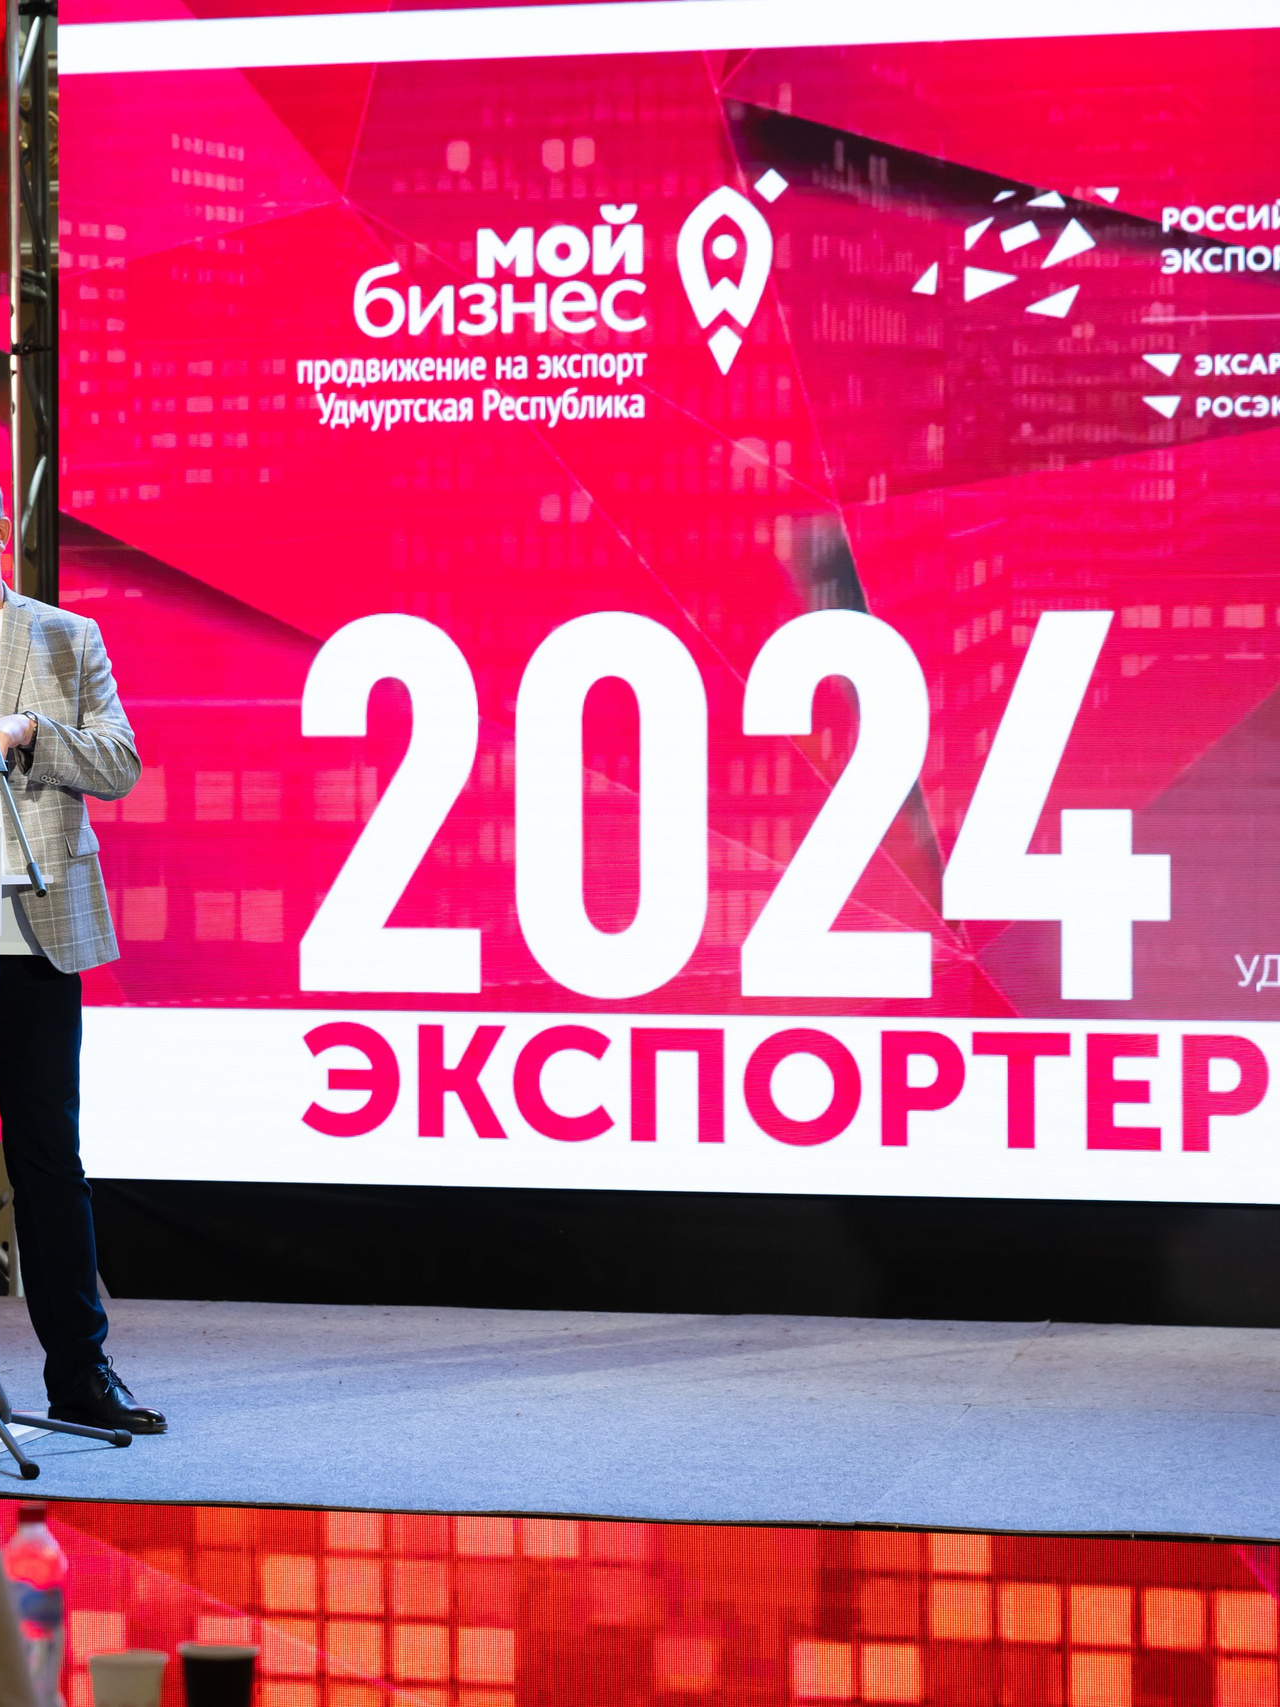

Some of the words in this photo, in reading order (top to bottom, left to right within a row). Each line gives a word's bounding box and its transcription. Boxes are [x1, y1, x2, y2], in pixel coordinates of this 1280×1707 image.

[353, 261, 647, 338] бизнес
[297, 355, 487, 390] продвижение
[495, 355, 528, 380] на
[537, 352, 648, 385] экспорт
[315, 391, 474, 433] Удмуртская
[482, 387, 645, 429] Республика
[299, 609, 1172, 1001] 2024
[301, 1021, 1271, 1153] ЭКСПОРТЕР
